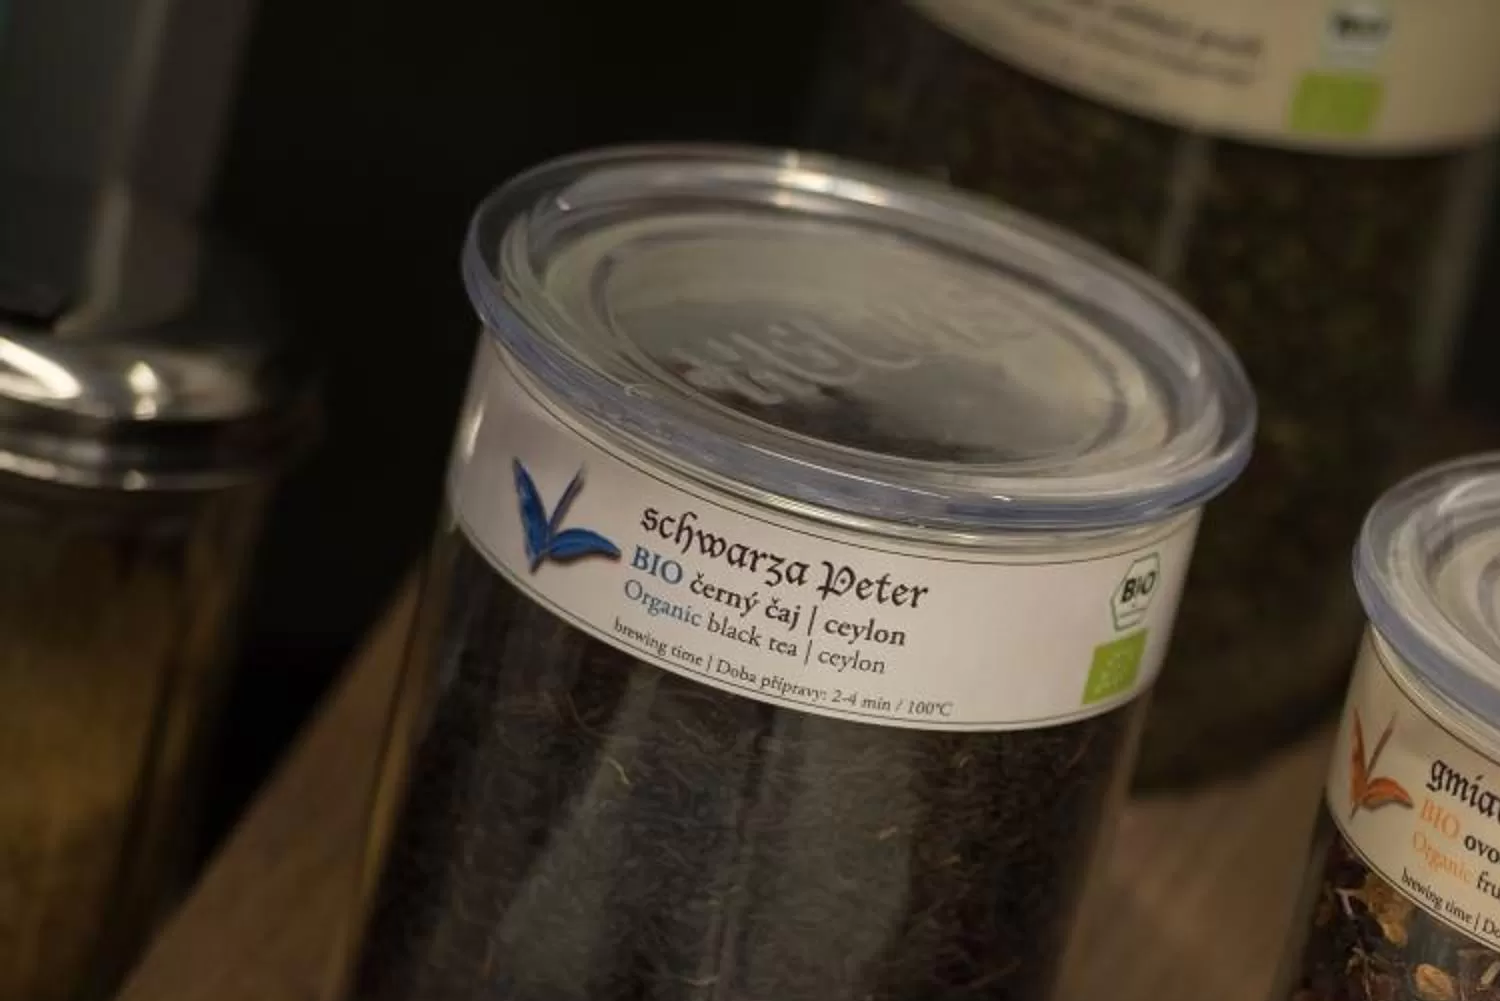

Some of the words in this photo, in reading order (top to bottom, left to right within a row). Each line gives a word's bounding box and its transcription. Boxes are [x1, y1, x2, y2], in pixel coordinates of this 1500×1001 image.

[630, 544, 683, 585] BIO
[690, 572, 760, 617] černý
[765, 598, 801, 631] čaj
[824, 618, 906, 646] ceylon
[640, 507, 810, 587] schwarza
[816, 560, 929, 608] Peter
[613, 616, 668, 656] brewing
[671, 645, 704, 667] time
[716, 659, 757, 684] Doba
[831, 689, 857, 703] 2-4
[860, 696, 891, 711] min
[624, 580, 701, 627] Organic
[707, 612, 762, 648] black
[769, 636, 798, 657] tea
[818, 650, 885, 674] ceylon
[1412, 831, 1471, 885] Organic
[1419, 798, 1461, 840] BIO
[1401, 867, 1444, 910] brewing
[1445, 900, 1472, 923] time
